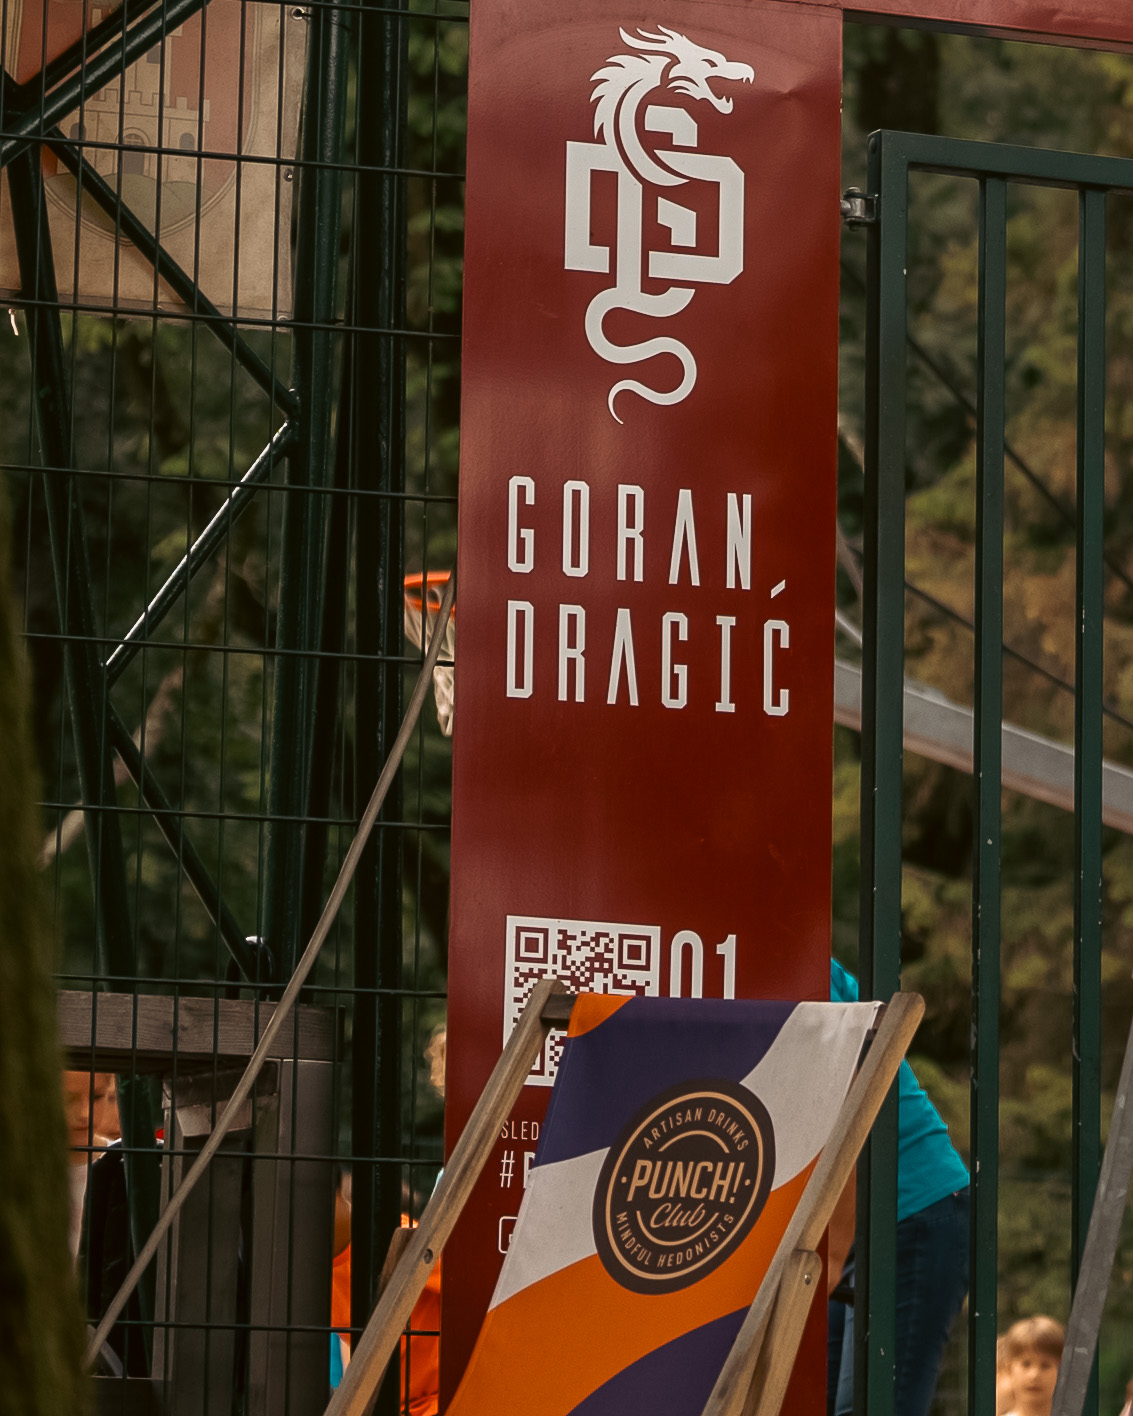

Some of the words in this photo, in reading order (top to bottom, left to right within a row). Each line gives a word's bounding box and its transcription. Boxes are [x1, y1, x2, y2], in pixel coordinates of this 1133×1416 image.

[507, 475, 752, 590] GORAN
[506, 579, 790, 717] DRAGIĆ
[501, 1120, 540, 1141] SLED
[643, 1107, 703, 1149] ARTISAN
[707, 1109, 749, 1151] DRINKS
[626, 1159, 745, 1204] PUNCH!
[650, 1202, 706, 1229] Club
[616, 1211, 652, 1266] MINDFUL
[657, 1213, 735, 1268] HEDONISTS
